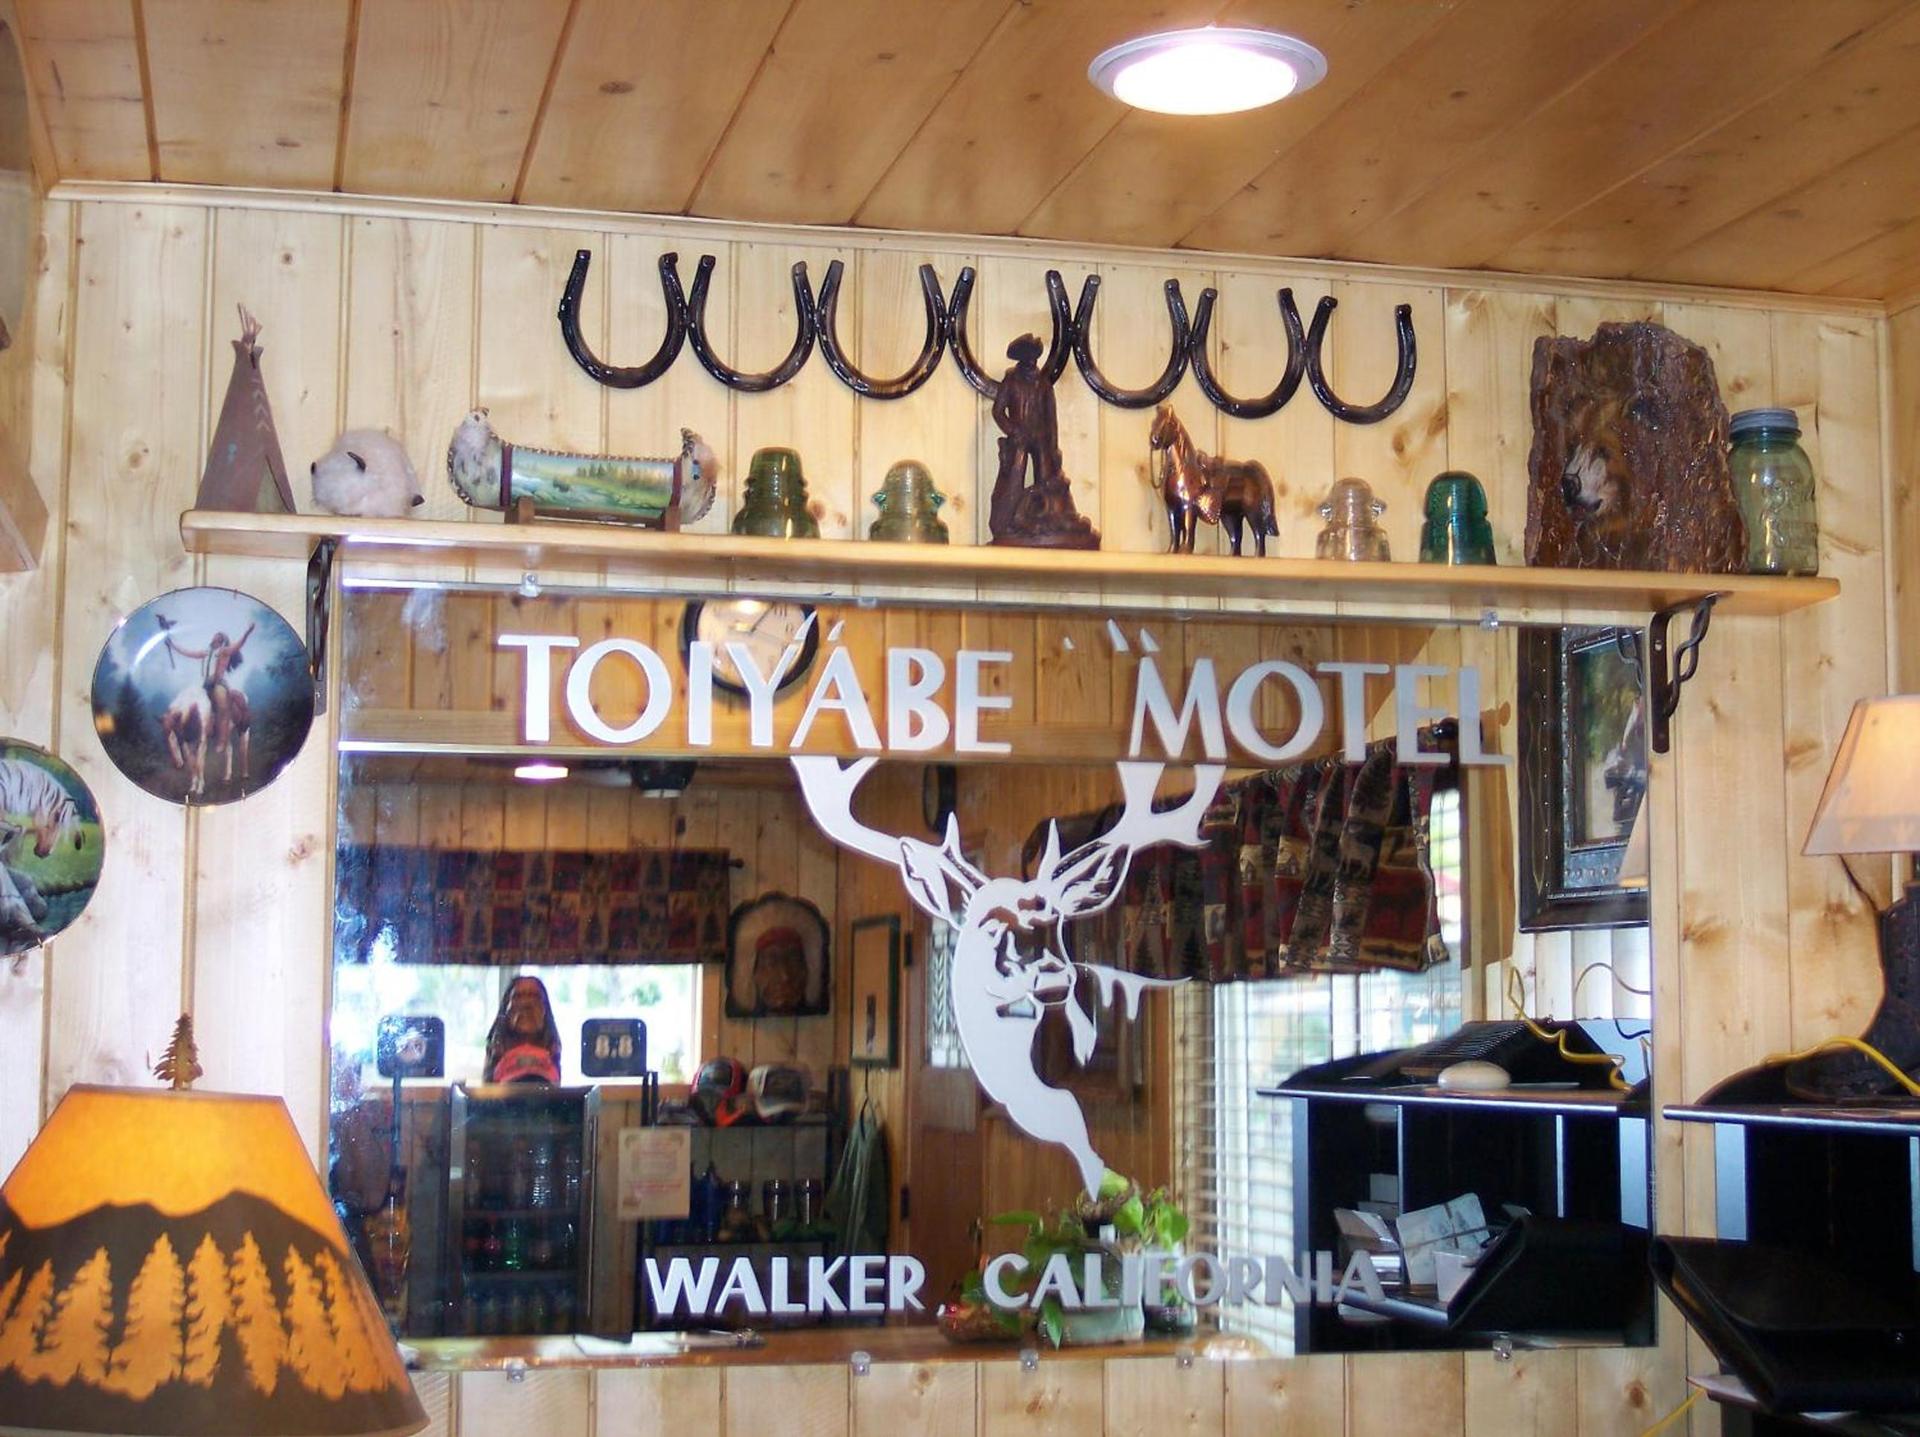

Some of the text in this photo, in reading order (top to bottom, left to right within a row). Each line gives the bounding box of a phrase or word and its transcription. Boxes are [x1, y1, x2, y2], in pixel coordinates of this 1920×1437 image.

[498, 634, 1513, 765] TOIYABE MOTEL
[983, 1249, 1386, 1310] CALIFORNIA
